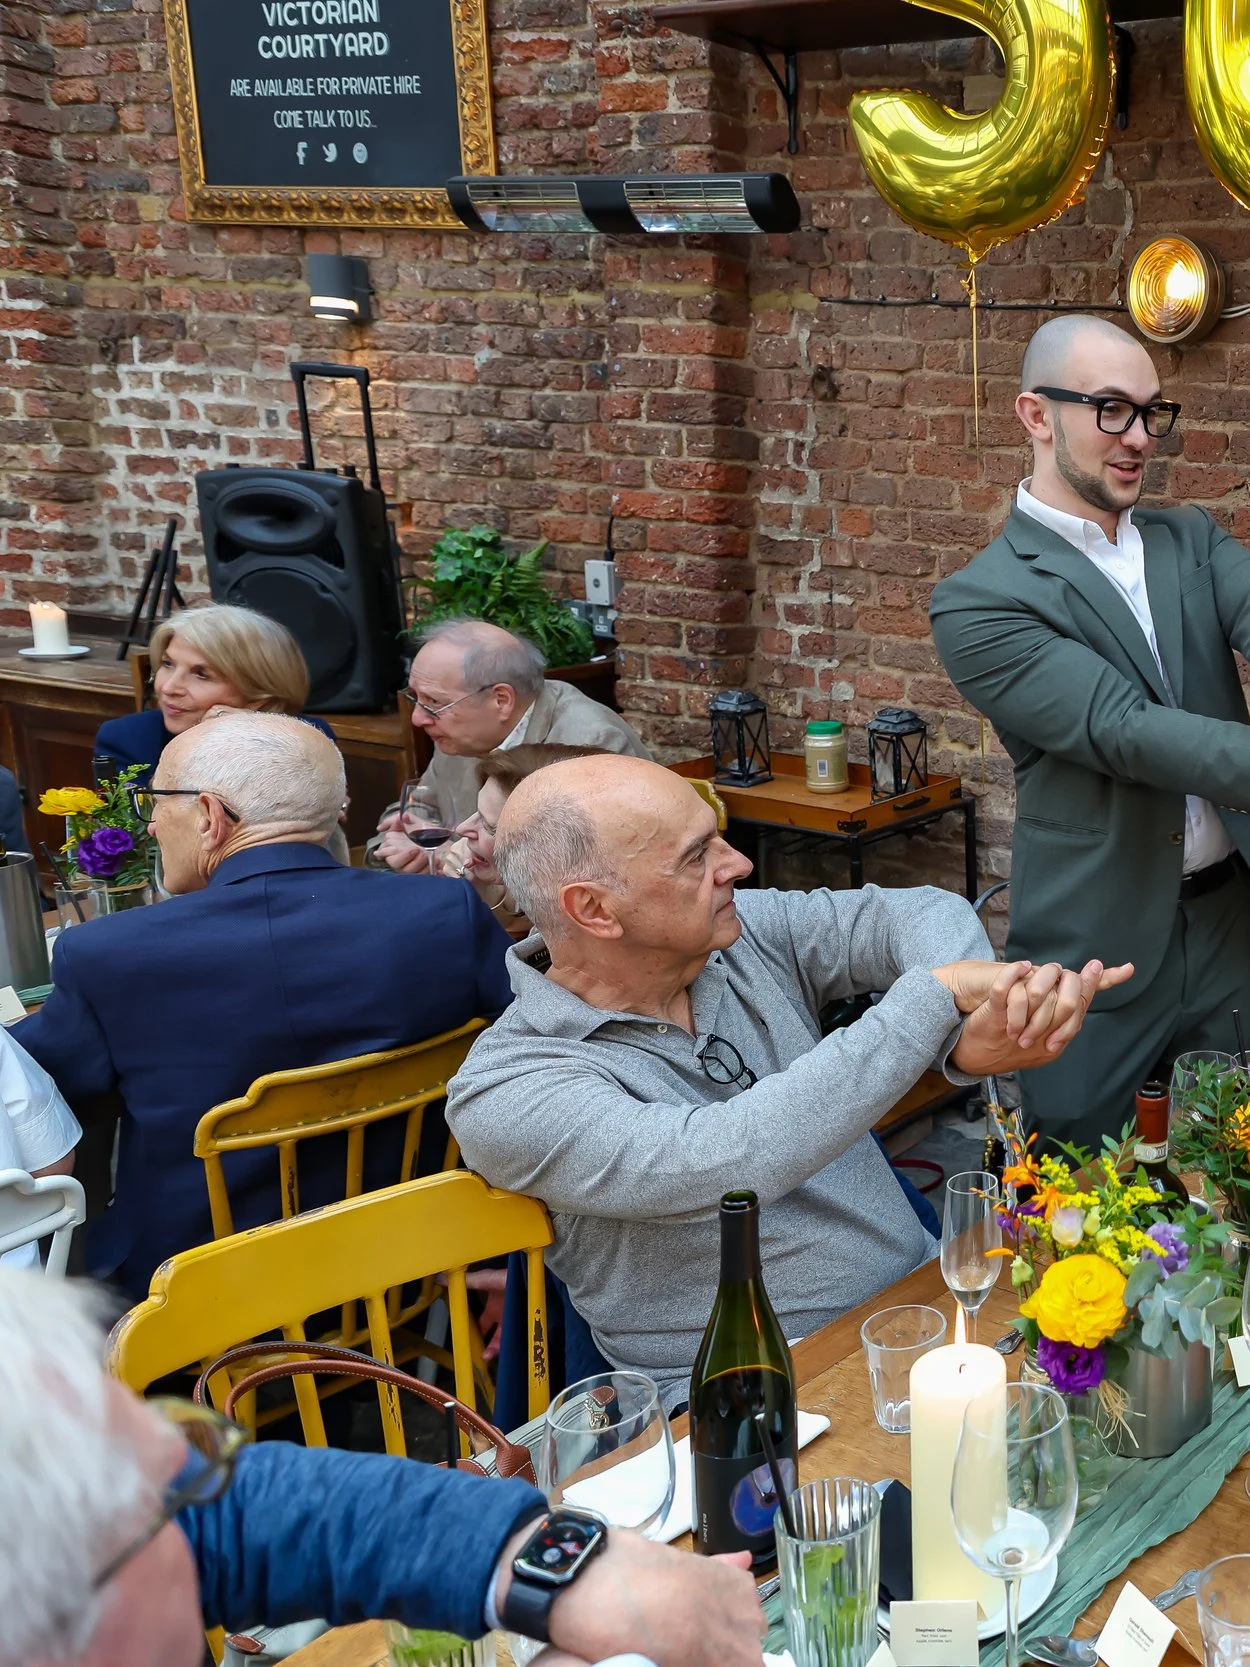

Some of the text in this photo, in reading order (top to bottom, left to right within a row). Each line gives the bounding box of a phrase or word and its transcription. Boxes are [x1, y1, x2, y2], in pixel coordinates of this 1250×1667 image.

[261, 0, 380, 26] VICTORIAN
[258, 31, 390, 59] COURTYARD
[230, 75, 422, 96] ARE AVAILABLE FOR PRIVATE HIRE
[273, 110, 304, 128] COME
[305, 110, 336, 128] TALK
[337, 110, 354, 128] TO
